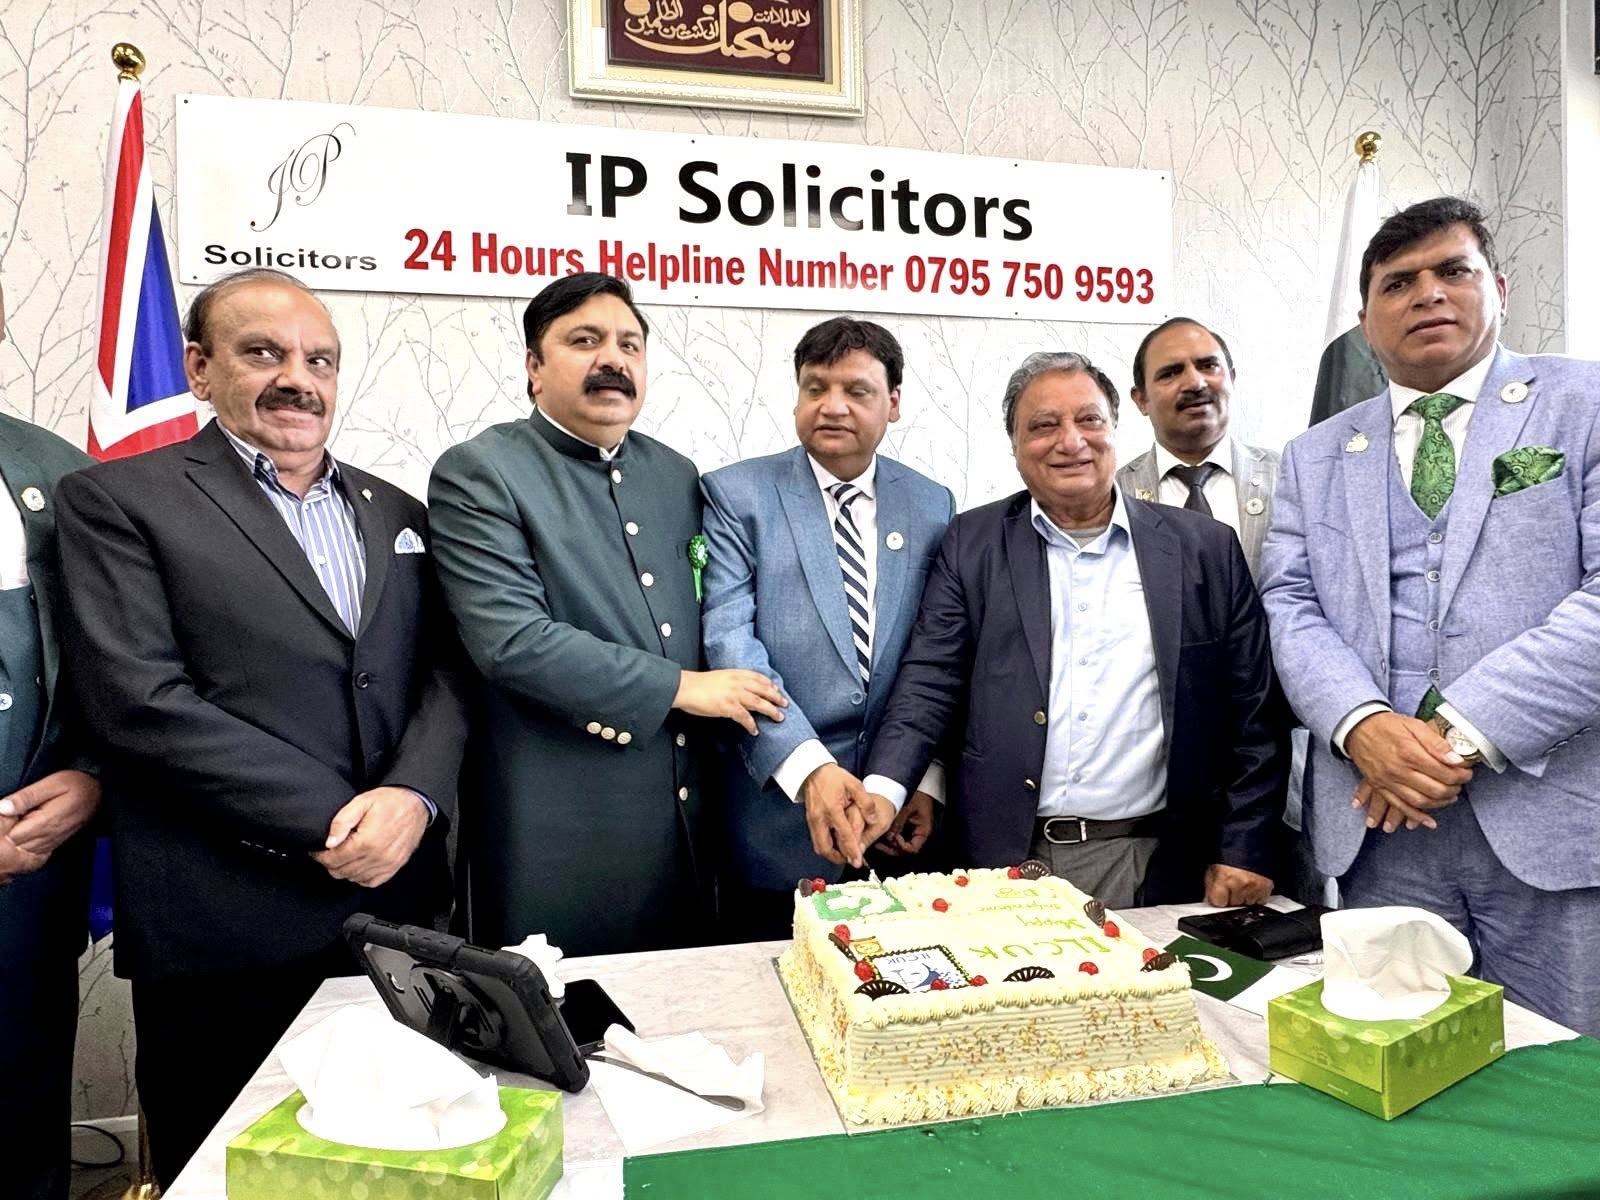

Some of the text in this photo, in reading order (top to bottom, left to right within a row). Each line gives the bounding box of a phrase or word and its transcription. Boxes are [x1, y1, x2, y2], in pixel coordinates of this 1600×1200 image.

[566, 152, 1033, 241] IP Solicitors
[204, 244, 378, 271] Solicitors
[404, 228, 1154, 304] 24 Hours Helpline Number 0795 750 9593
